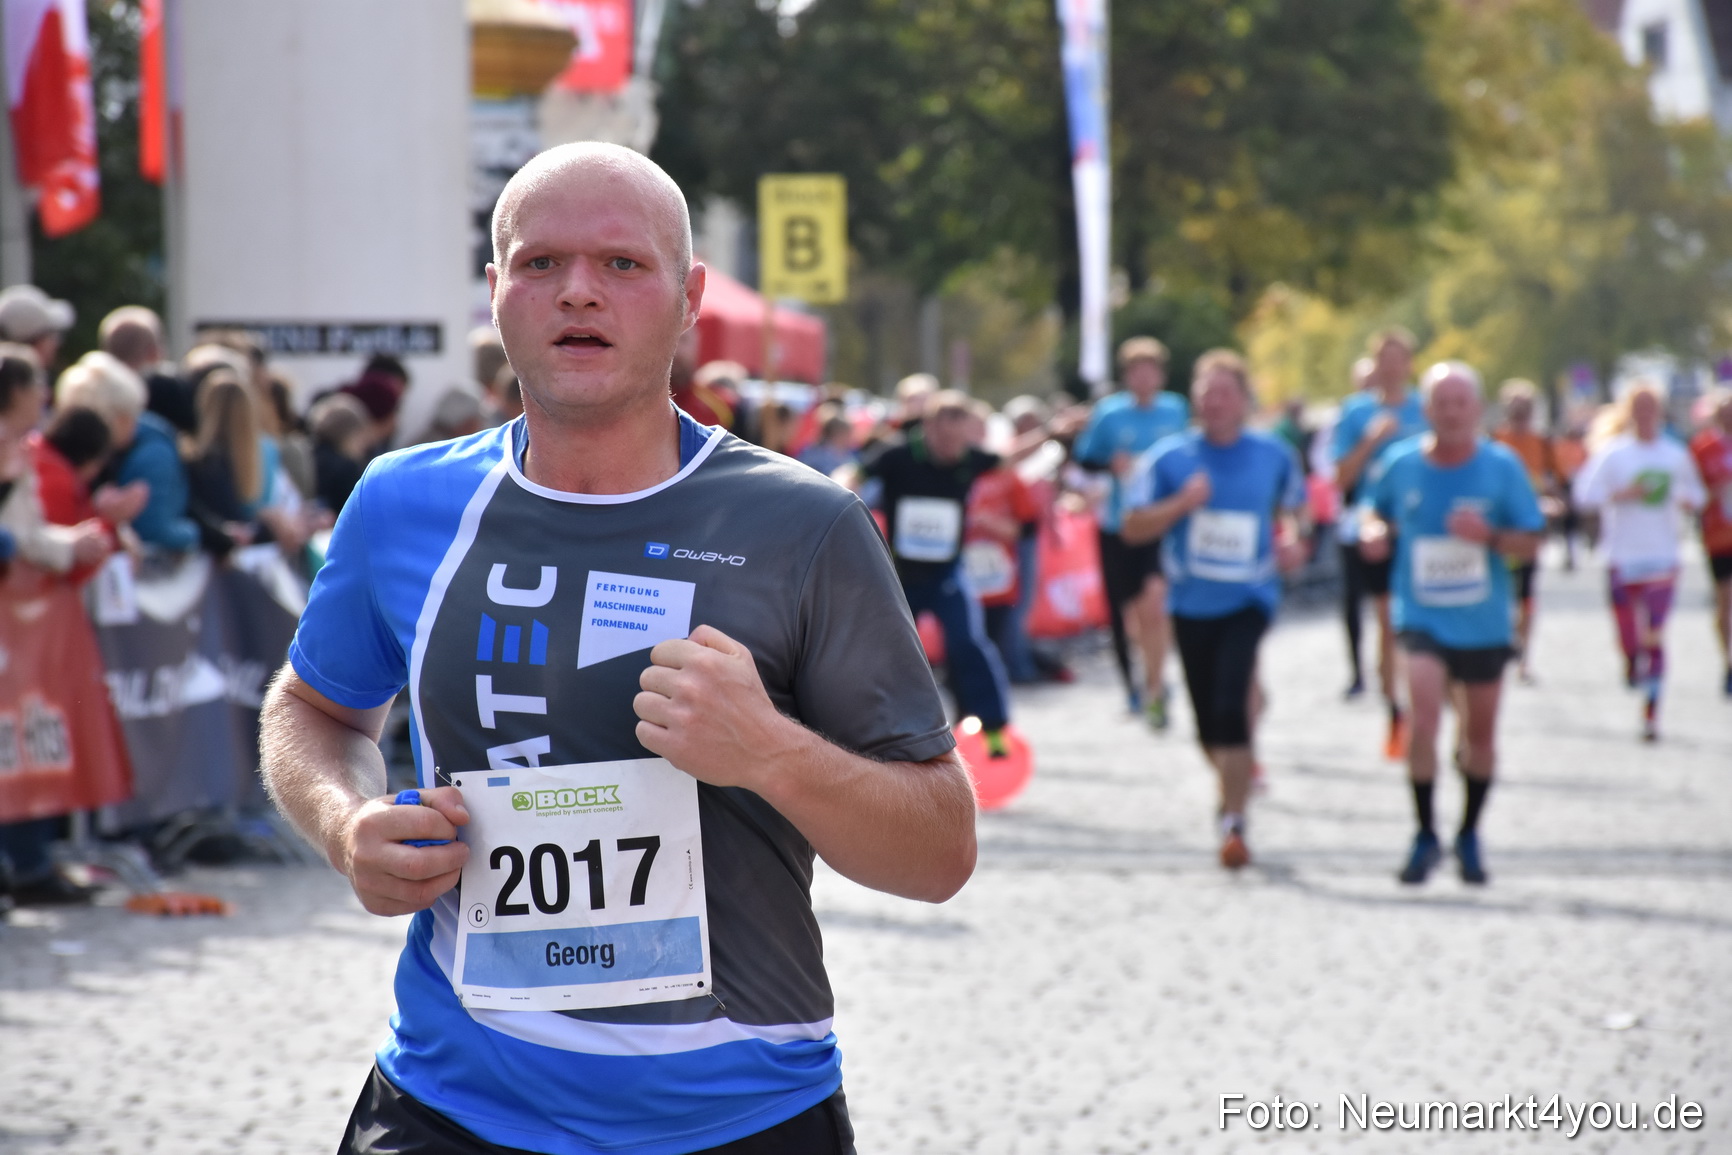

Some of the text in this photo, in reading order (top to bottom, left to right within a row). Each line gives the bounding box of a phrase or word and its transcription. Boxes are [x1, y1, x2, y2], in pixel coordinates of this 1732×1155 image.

[785, 214, 824, 273] B
[596, 583, 660, 598] FERTIGUNG
[593, 600, 666, 616] MASCHINENBAU
[591, 618, 648, 631] FORMENBAU
[535, 785, 622, 810] BOCK
[536, 810, 562, 818] inspired
[572, 807, 592, 815] smart
[593, 805, 624, 814] concepts
[489, 835, 661, 917] 2017
[475, 909, 483, 922] C
[545, 941, 615, 968] Georg
